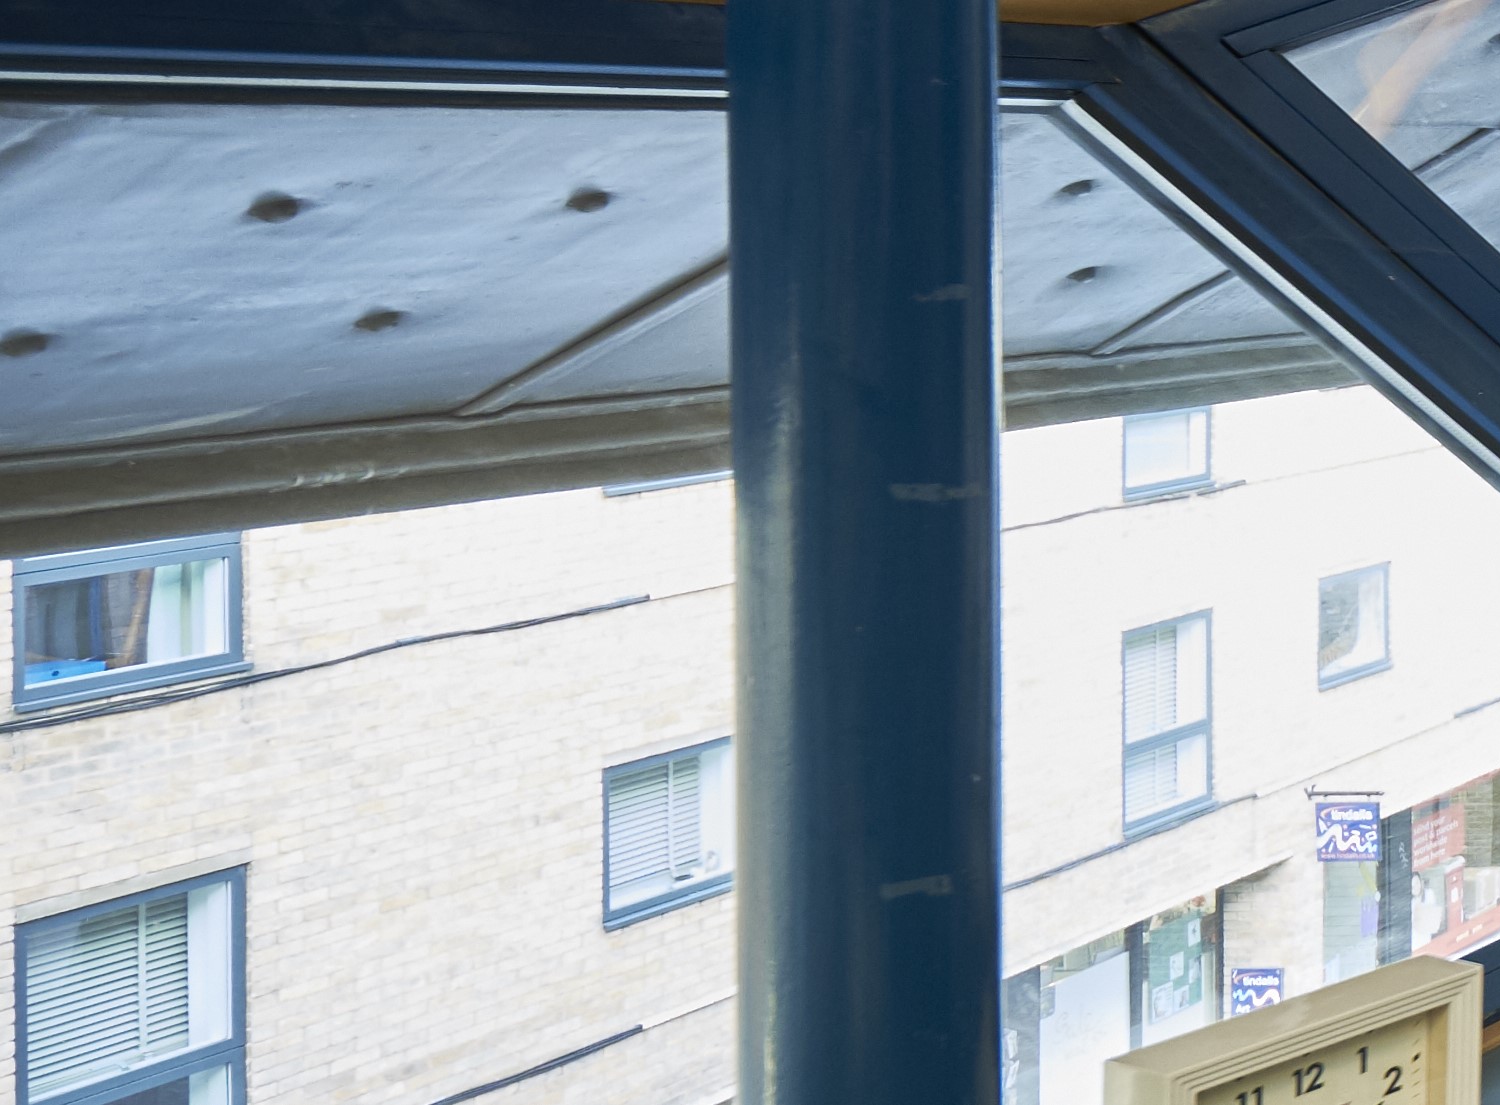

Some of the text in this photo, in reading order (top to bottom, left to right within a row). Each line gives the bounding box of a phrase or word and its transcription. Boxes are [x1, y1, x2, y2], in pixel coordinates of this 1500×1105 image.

[1356, 1046, 1369, 1074] 1
[1292, 1062, 1325, 1097] 12
[1383, 1065, 1403, 1096] 2
